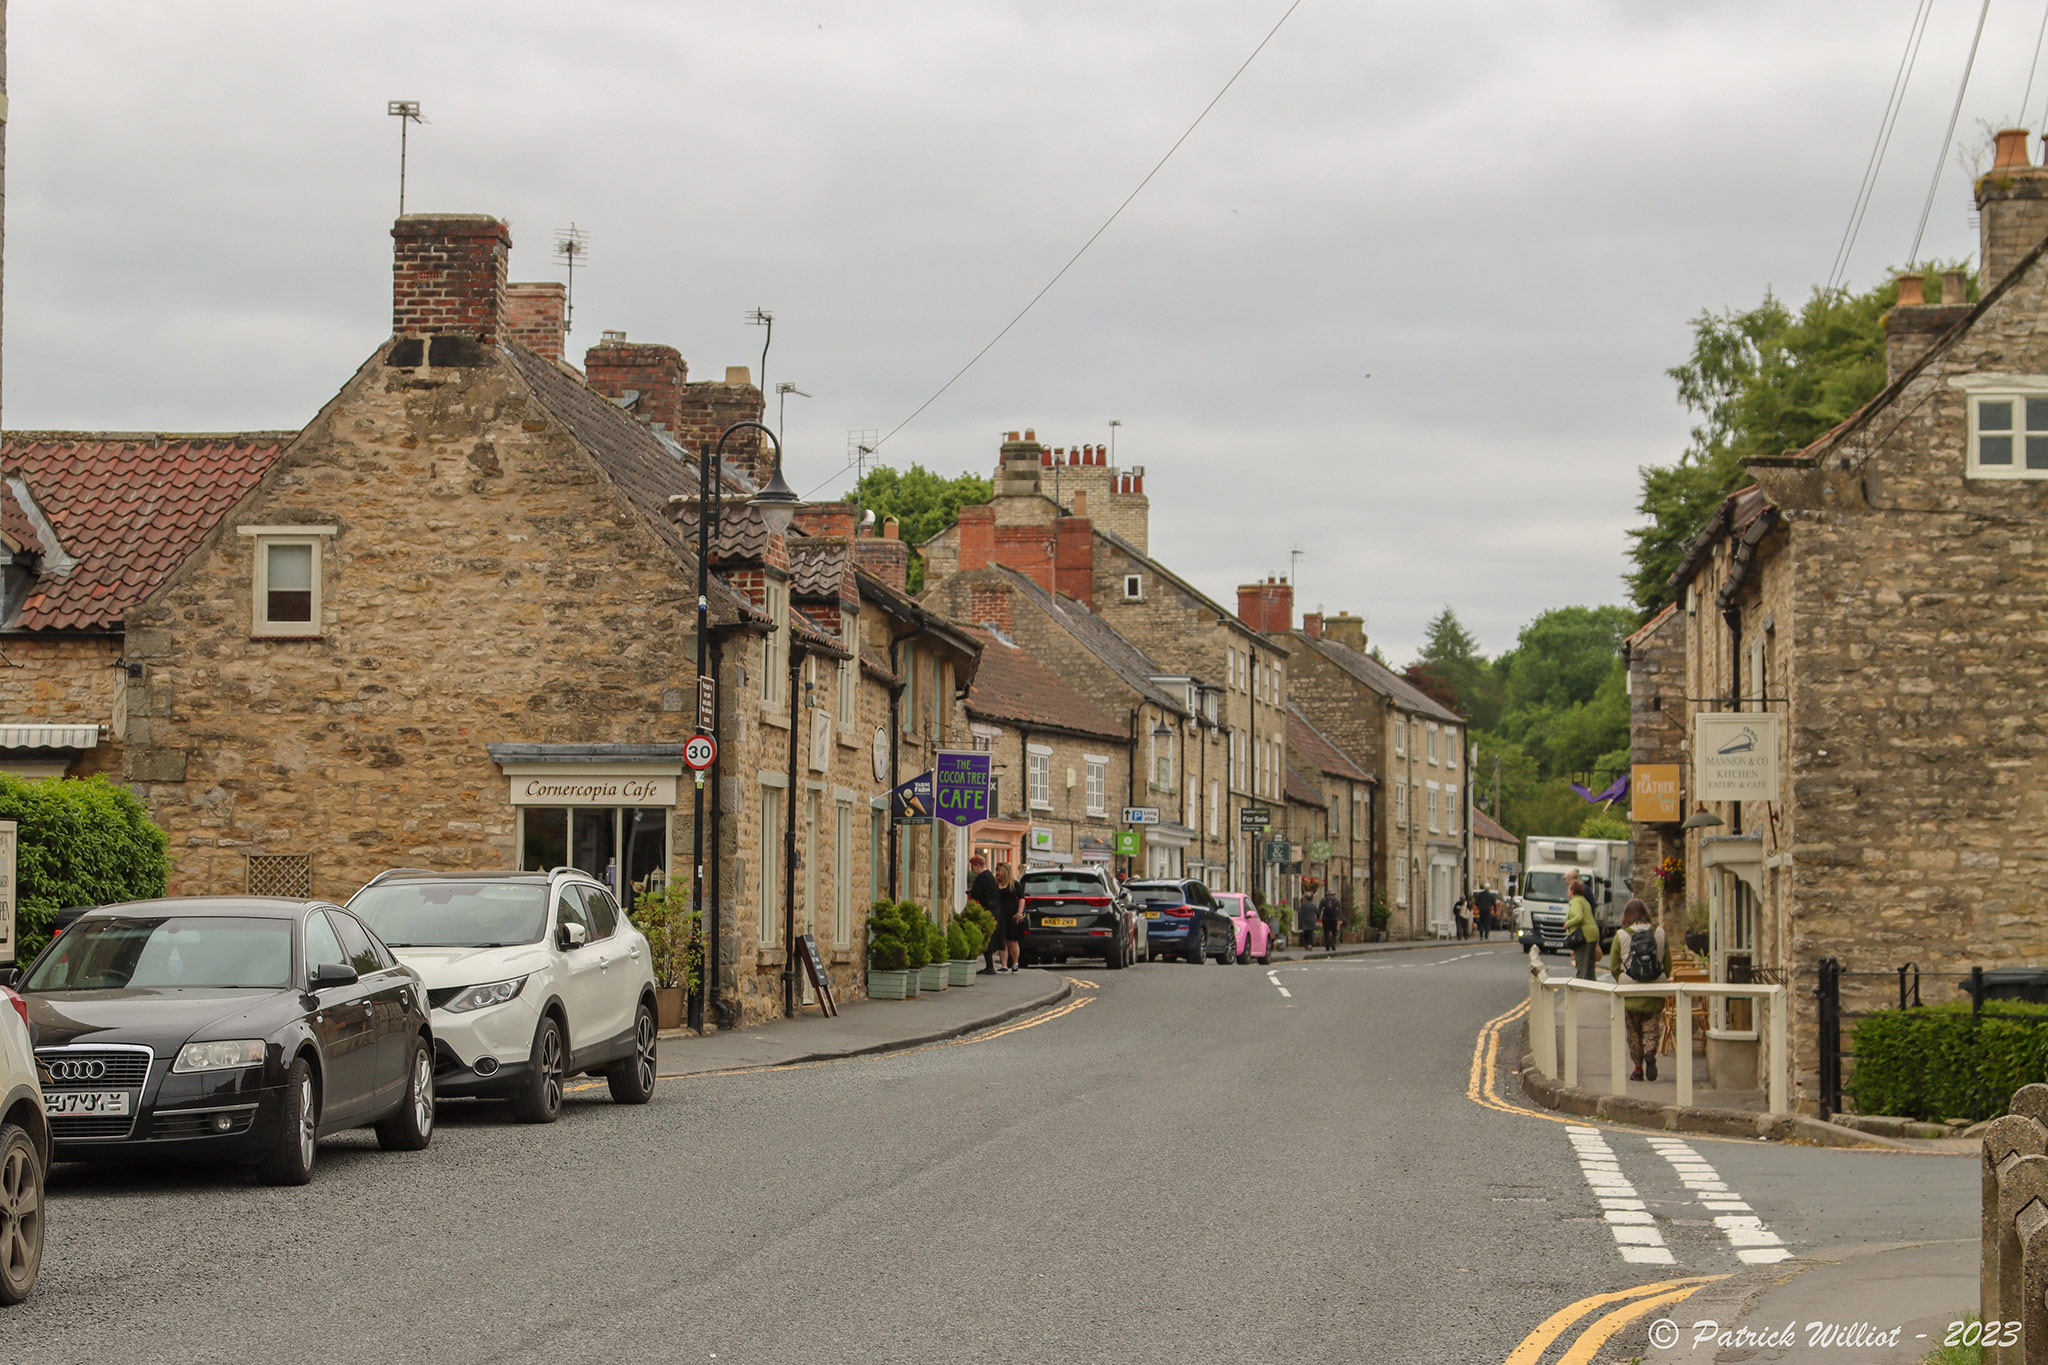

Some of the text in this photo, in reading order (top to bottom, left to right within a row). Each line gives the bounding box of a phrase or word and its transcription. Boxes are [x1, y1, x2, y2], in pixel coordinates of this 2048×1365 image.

[688, 745, 711, 759] 30
[956, 759, 972, 770] THE
[1707, 756, 1747, 766] MANNION
[1748, 756, 1756, 766] &
[939, 770, 987, 785] COCOA TREE
[1717, 770, 1758, 778] KITCHEN
[525, 780, 657, 802] Cornercopia Cafe
[1636, 781, 1675, 793] FEATHER
[938, 788, 985, 810] CAFE
